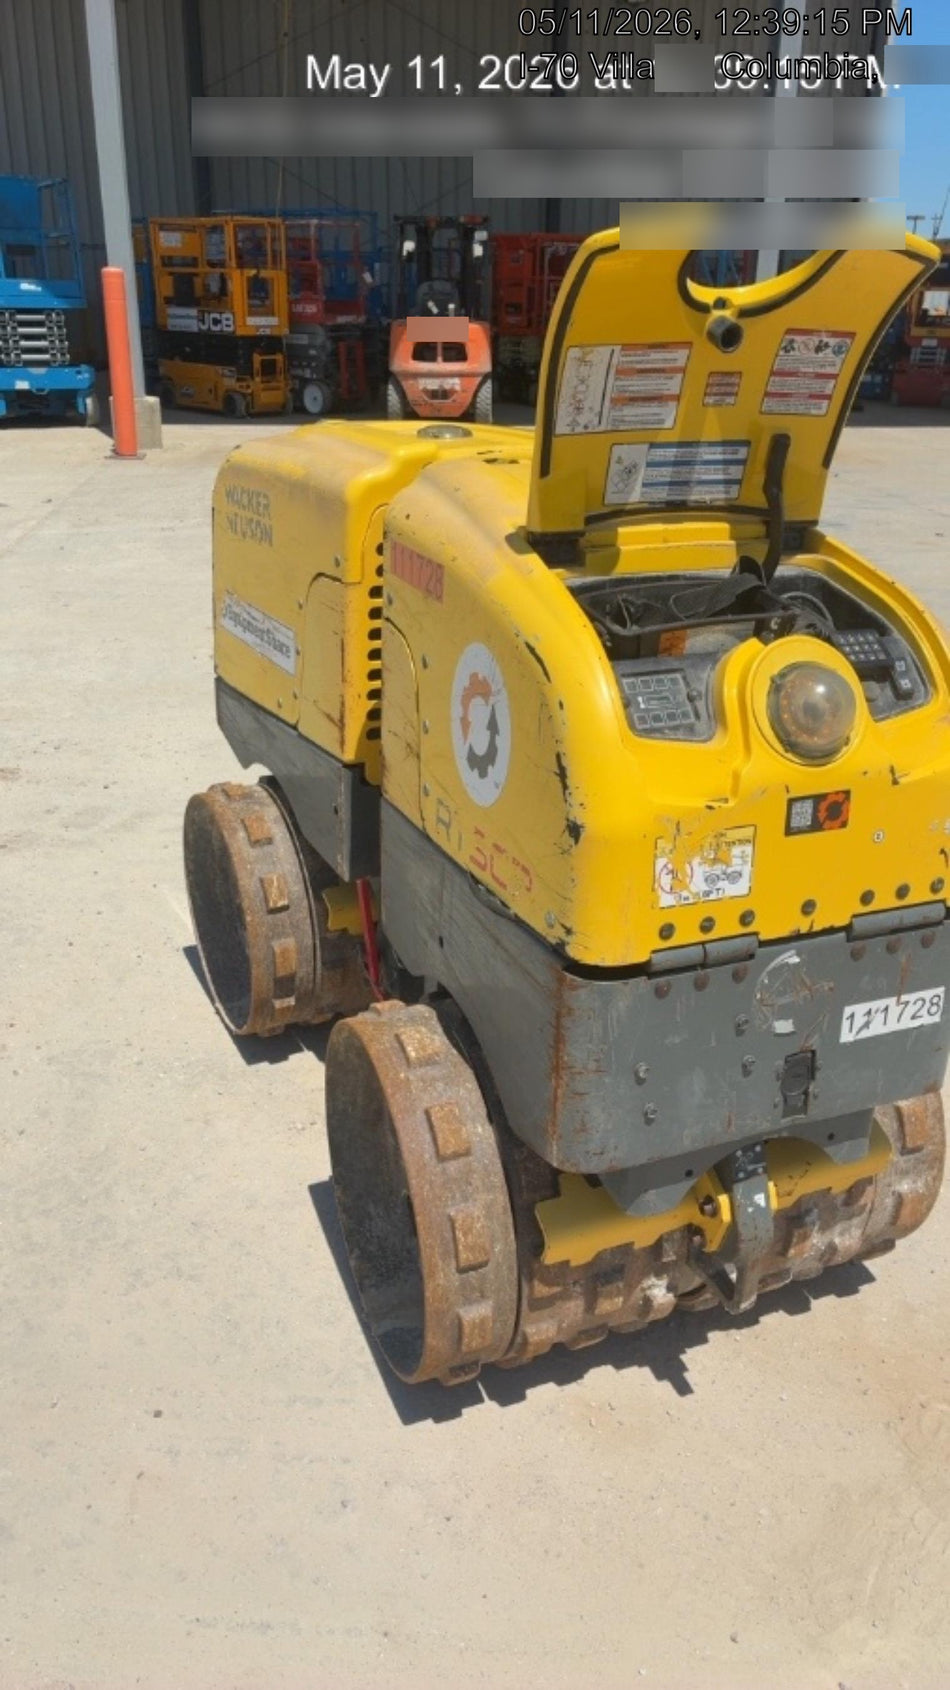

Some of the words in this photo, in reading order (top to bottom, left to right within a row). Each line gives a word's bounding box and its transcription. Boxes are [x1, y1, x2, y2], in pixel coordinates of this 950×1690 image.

[199, 310, 235, 331] JCB
[225, 484, 271, 520] WACKER
[845, 994, 942, 1035] 111728
